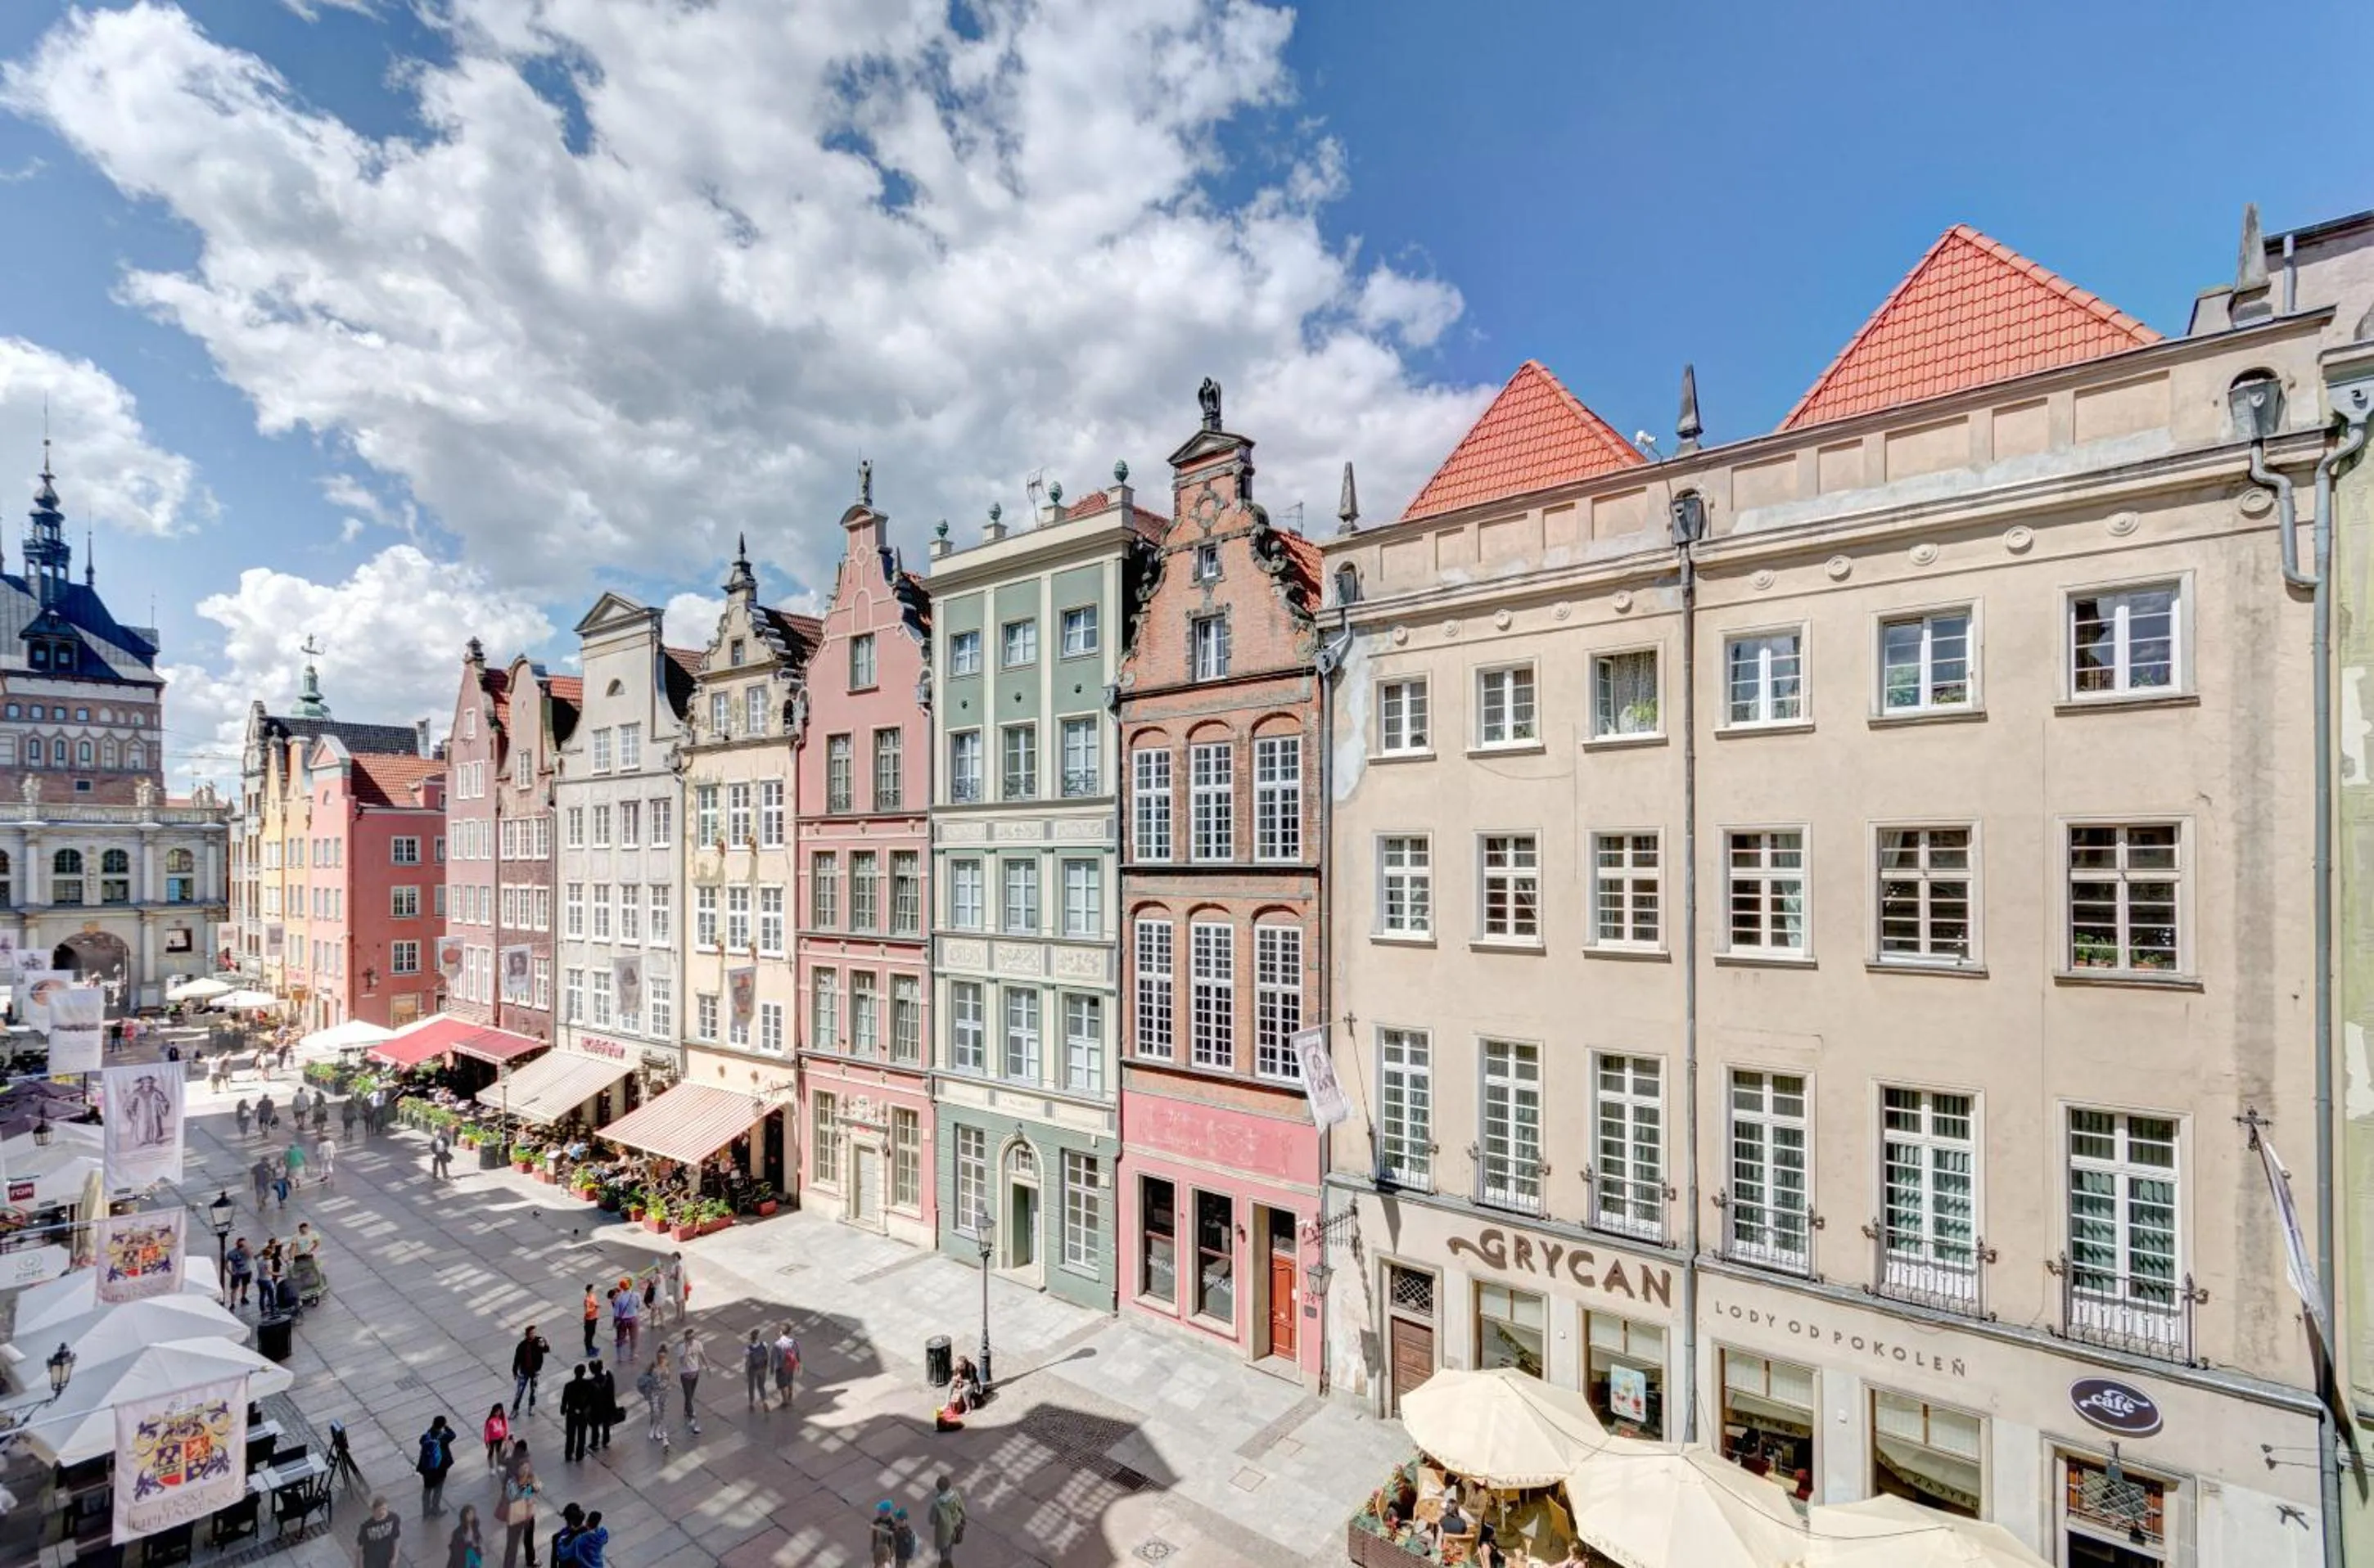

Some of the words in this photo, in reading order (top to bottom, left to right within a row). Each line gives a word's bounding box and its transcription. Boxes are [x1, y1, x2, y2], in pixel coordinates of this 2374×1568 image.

[1447, 1228, 1672, 1308] GRYCAN
[1715, 1300, 1776, 1327] LODY
[1788, 1319, 1820, 1339] OD
